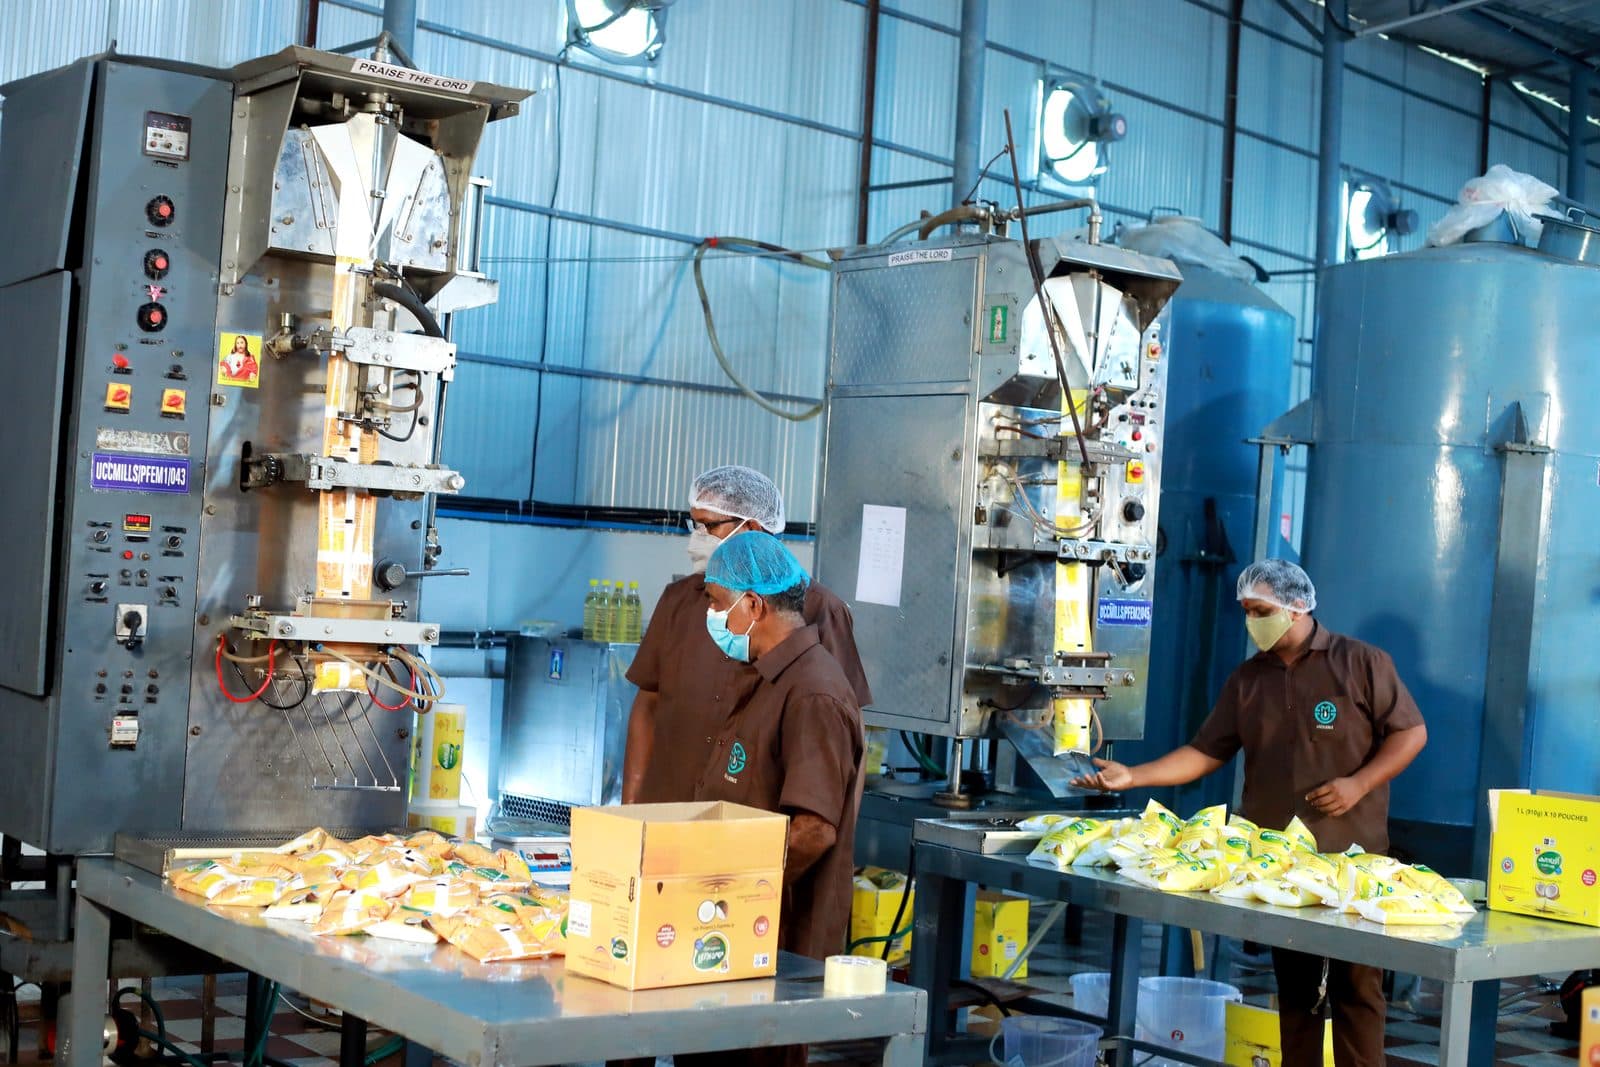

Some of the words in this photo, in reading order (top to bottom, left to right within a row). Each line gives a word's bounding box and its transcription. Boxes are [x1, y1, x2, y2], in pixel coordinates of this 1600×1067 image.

[359, 62, 406, 79] PRAISE
[409, 73, 433, 85] THE
[434, 79, 468, 91] LORD
[891, 252, 914, 264] PRAISE
[915, 250, 929, 259] THE
[930, 250, 949, 259] LORD
[1558, 812, 1588, 822] POUCHES
